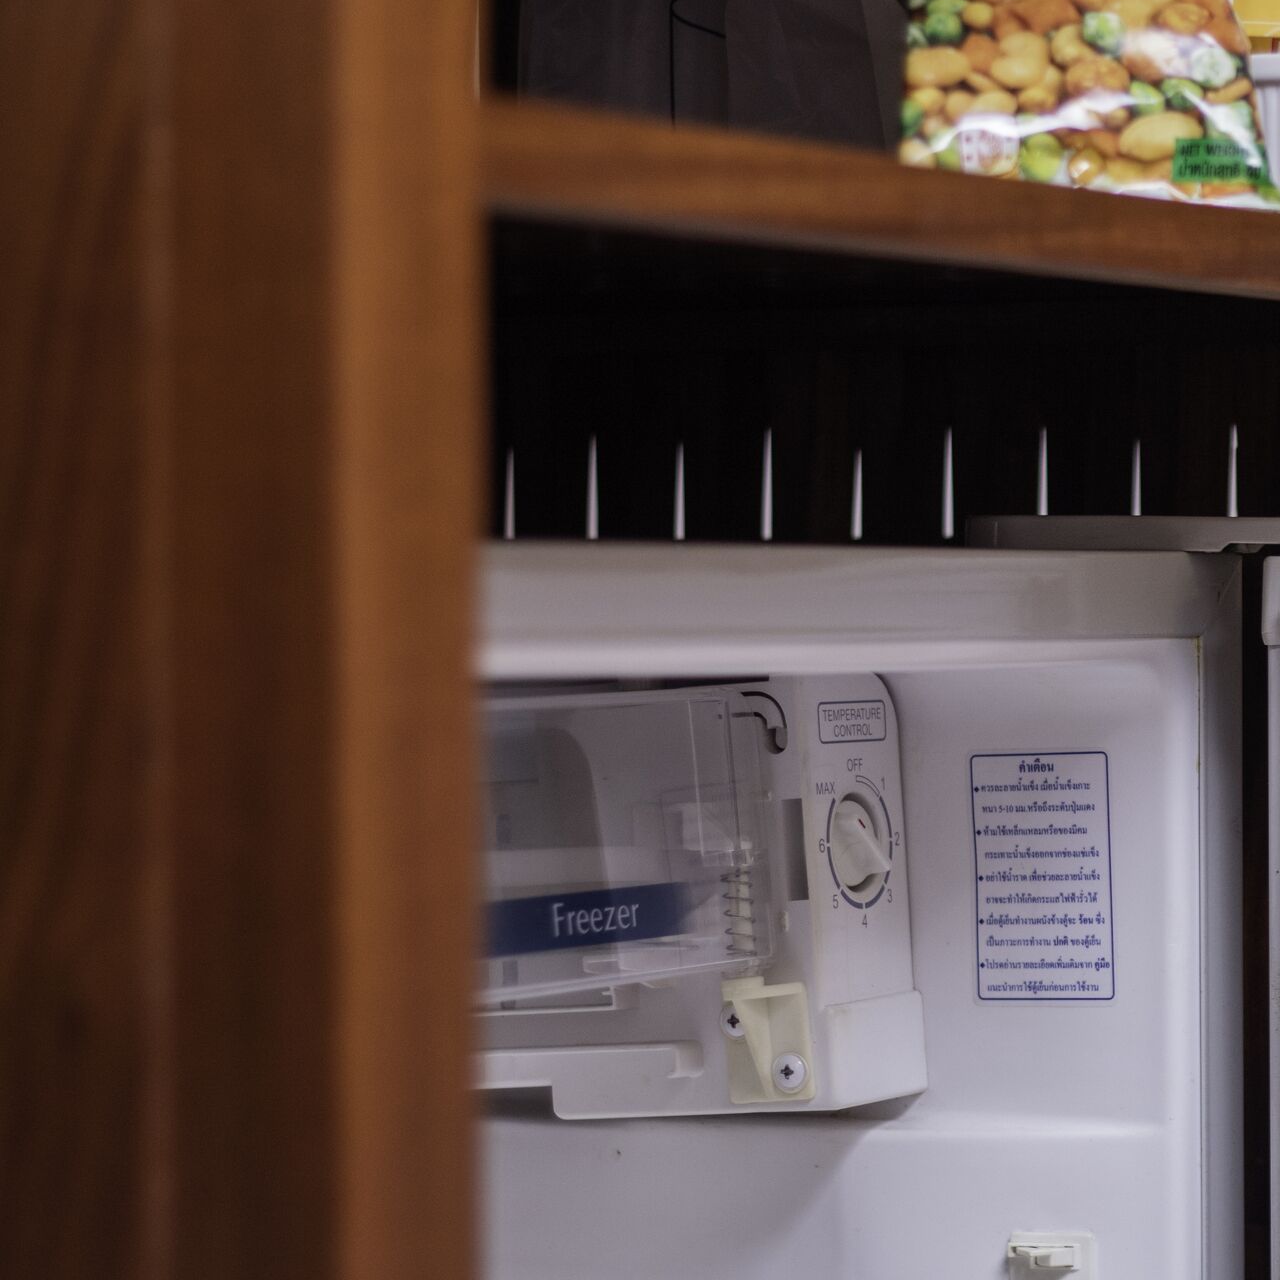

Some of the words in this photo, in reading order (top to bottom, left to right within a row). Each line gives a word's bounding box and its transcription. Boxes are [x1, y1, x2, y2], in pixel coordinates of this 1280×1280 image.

[822, 707, 882, 721] TEMPERATURE
[833, 723, 873, 737] CONTROL
[846, 758, 863, 772] OFF
[1019, 758, 1054, 773] คำเตือน
[816, 782, 836, 795] MAX
[881, 777, 886, 791] 1
[999, 804, 1014, 813] 5-10
[818, 838, 826, 853] 6
[894, 831, 901, 847] 2
[832, 894, 839, 909] 5
[887, 888, 893, 904] 3
[552, 902, 639, 937] Freezer
[861, 913, 868, 928] 4
